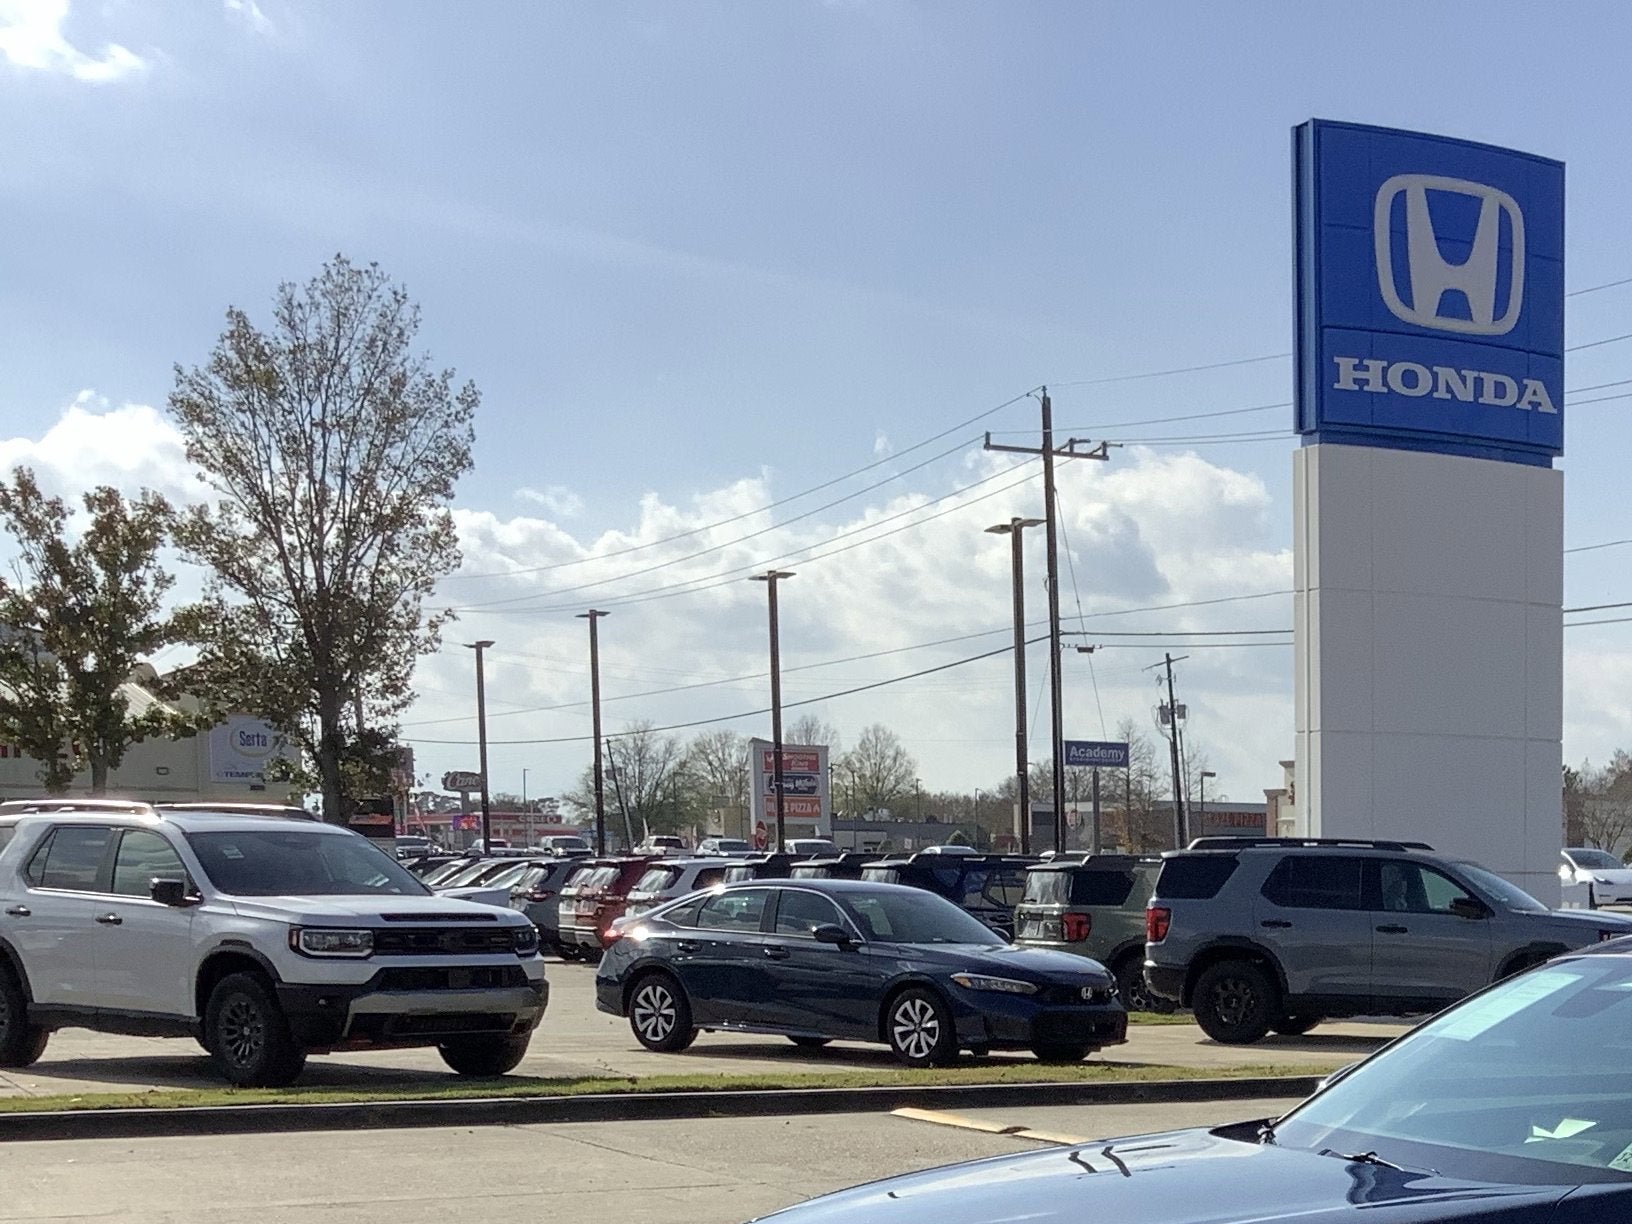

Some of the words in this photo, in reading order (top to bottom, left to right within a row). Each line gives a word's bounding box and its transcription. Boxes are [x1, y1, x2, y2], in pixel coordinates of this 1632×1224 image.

[1333, 356, 1558, 414] HONDA
[239, 731, 268, 747] Serta
[1069, 745, 1125, 761] Academy
[790, 802, 812, 813] PIZZA
